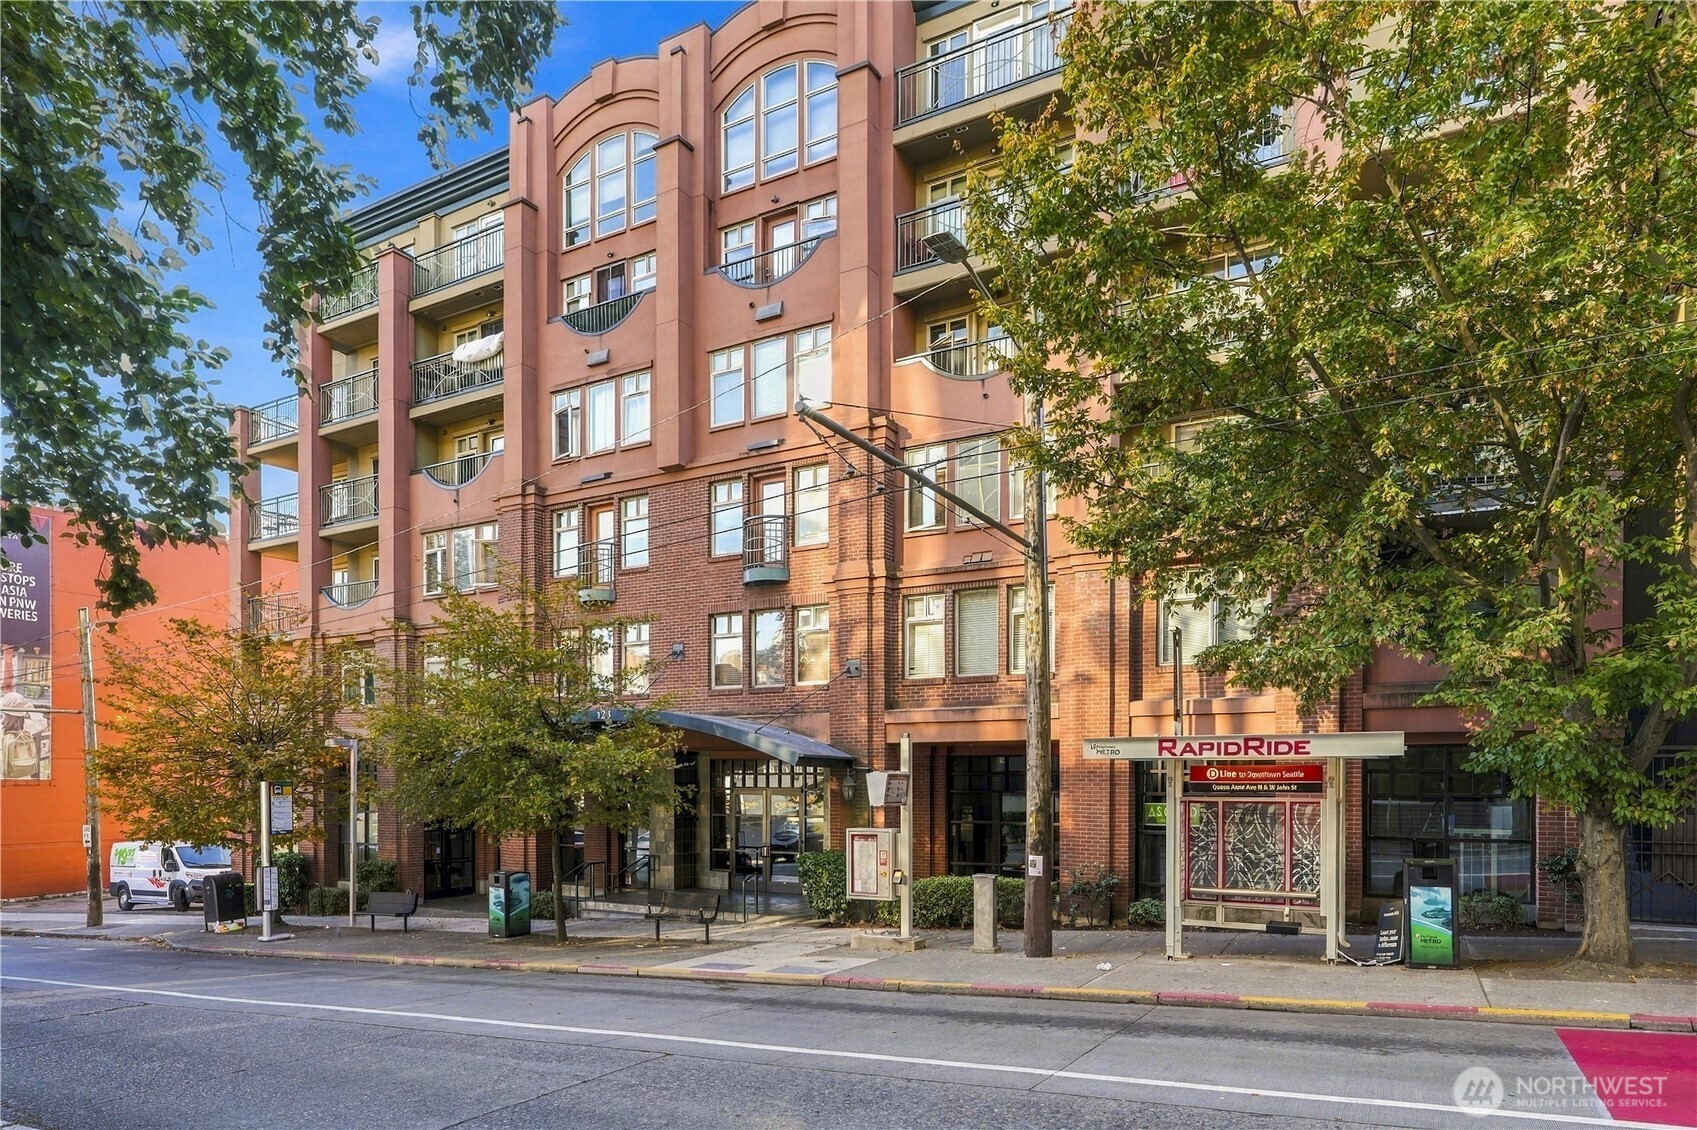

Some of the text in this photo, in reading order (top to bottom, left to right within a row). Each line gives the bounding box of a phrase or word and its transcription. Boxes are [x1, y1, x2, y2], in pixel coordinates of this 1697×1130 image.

[0, 573, 36, 587] STOPS
[1, 584, 28, 598] ASIA
[9, 597, 37, 610] PNW
[1220, 770, 1237, 778] Line
[1282, 770, 1305, 778] Seattle
